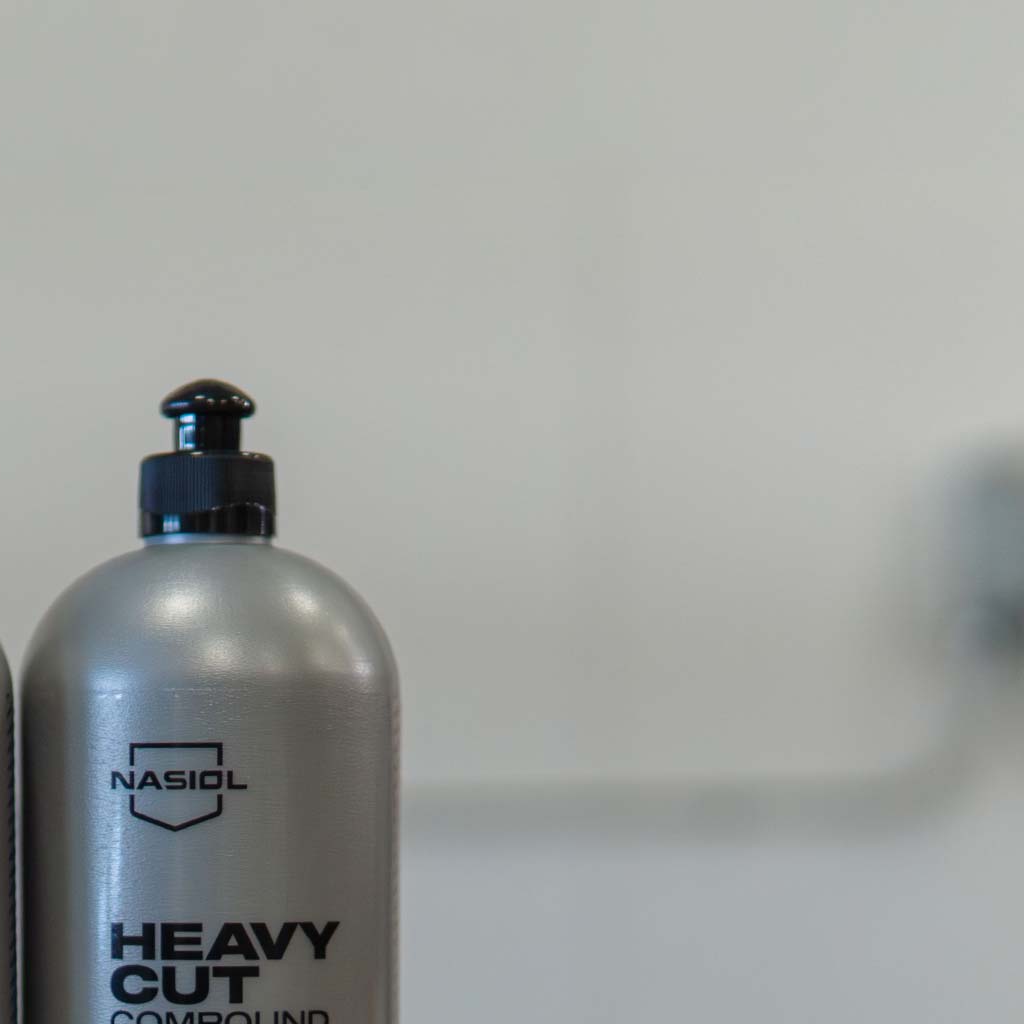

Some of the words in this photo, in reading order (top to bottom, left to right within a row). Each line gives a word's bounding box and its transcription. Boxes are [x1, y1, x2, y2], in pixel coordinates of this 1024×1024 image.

[110, 770, 247, 790] NASIOL
[110, 921, 340, 961] HEAVY
[110, 964, 260, 1005] CUT
